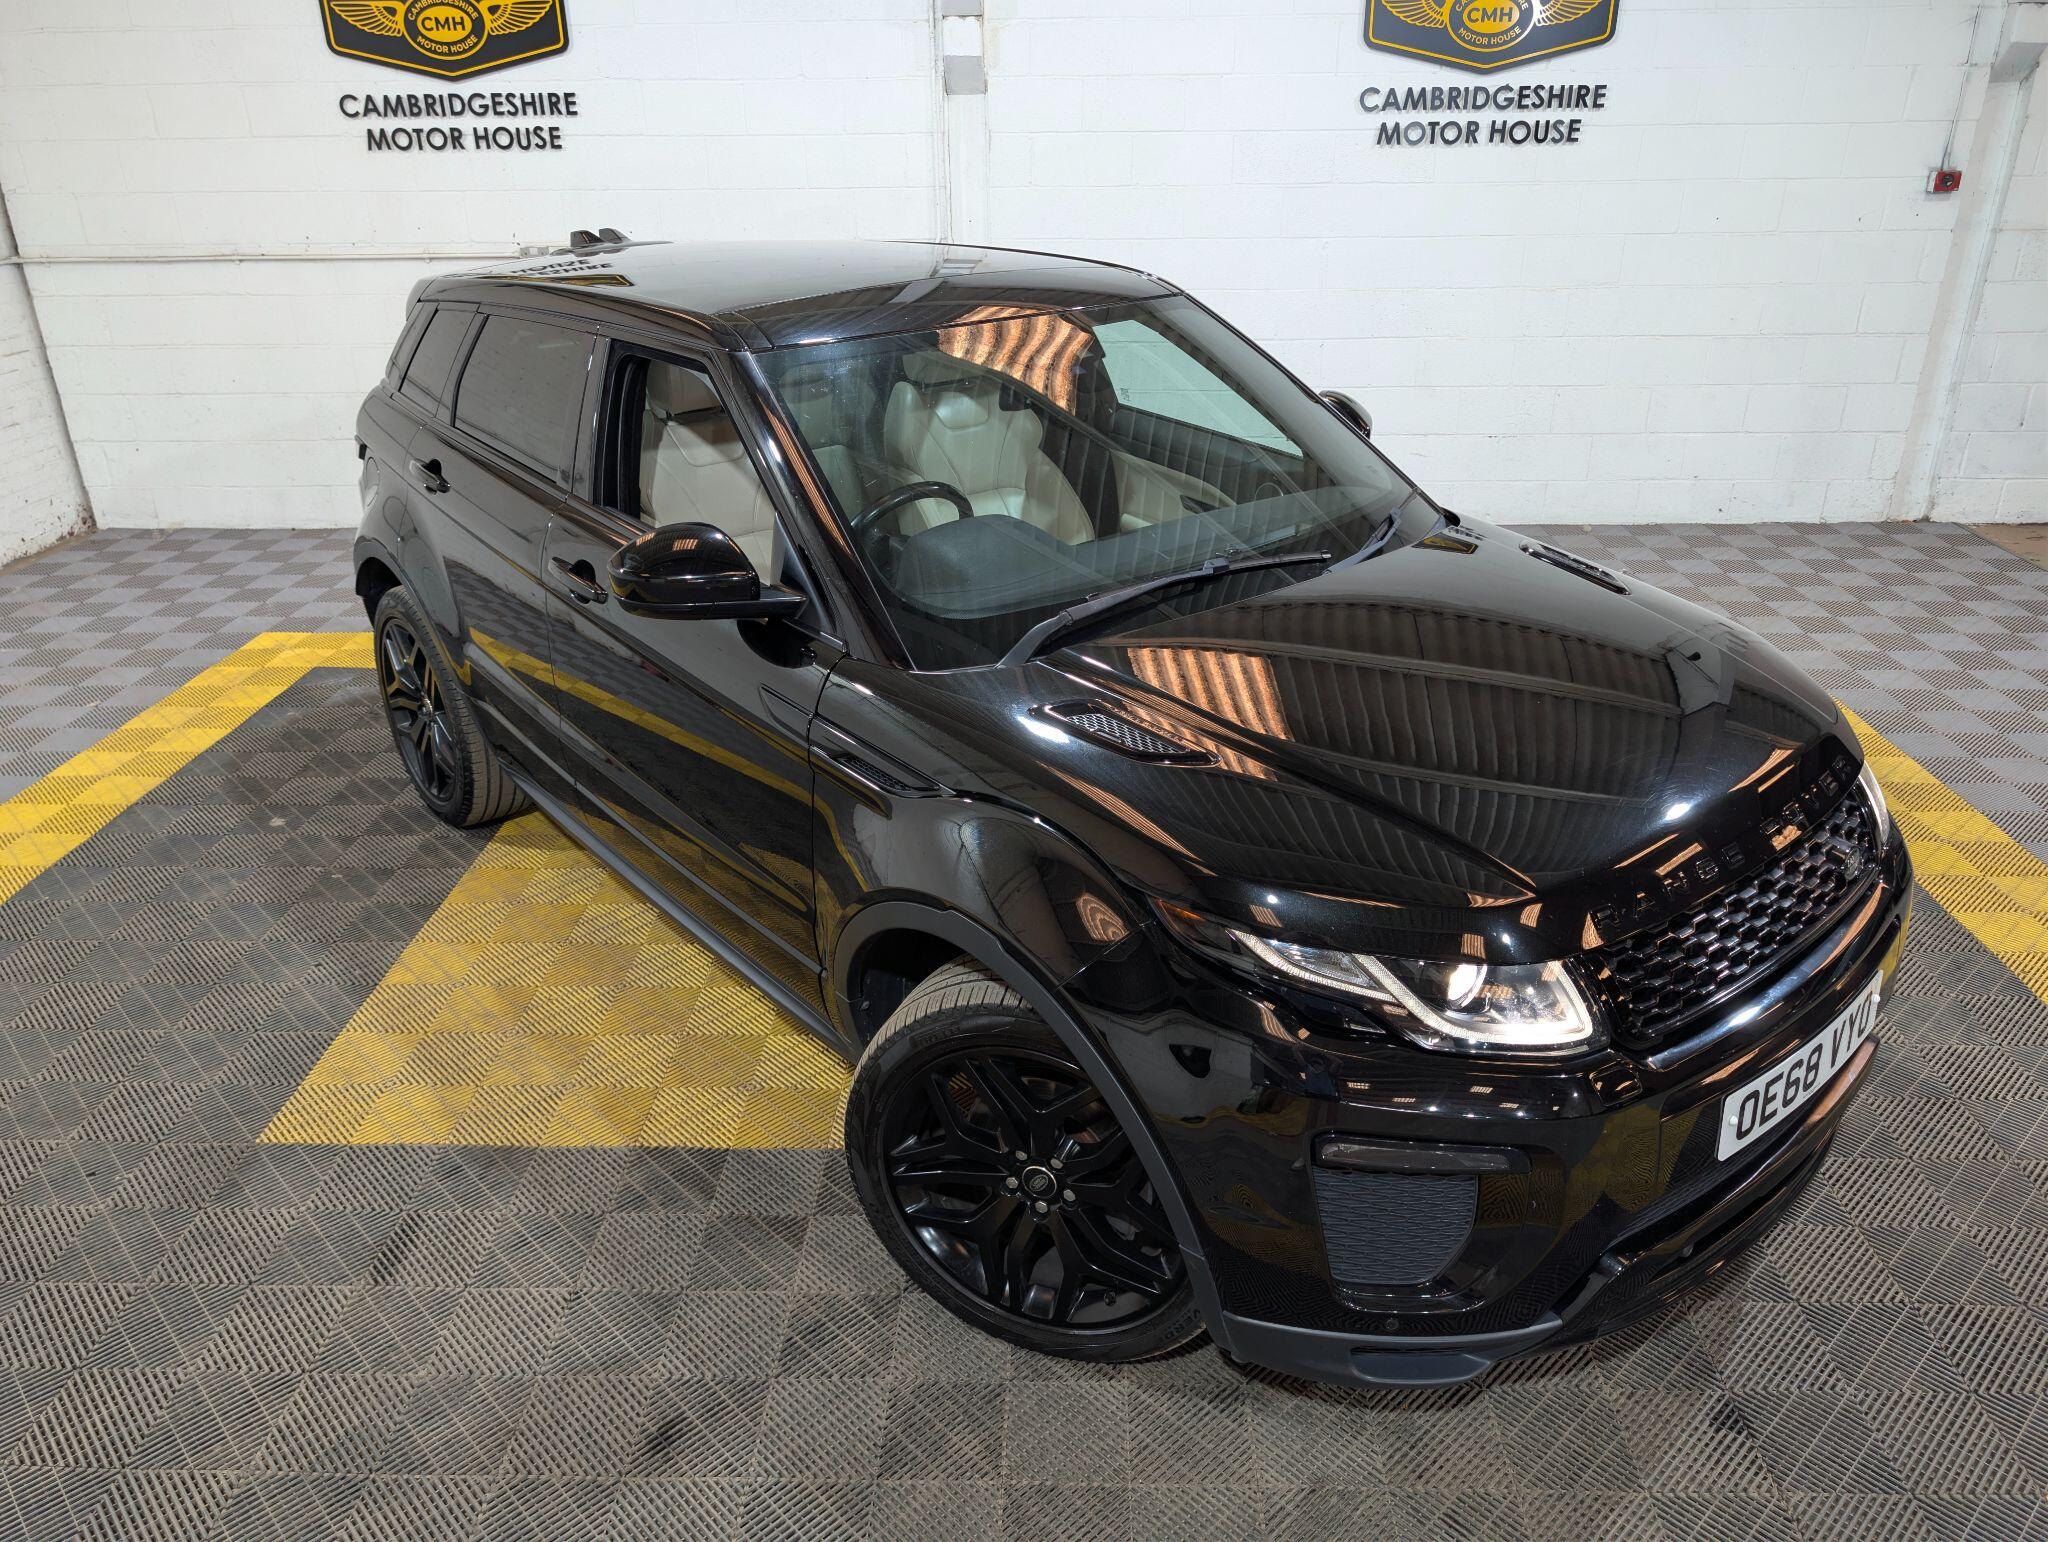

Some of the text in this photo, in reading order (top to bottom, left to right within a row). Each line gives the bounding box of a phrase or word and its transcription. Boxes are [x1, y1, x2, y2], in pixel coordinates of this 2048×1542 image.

[421, 16, 466, 32] CMH
[1467, 7, 1513, 23] CMH
[417, 34, 478, 53] MOTOR HOUSE
[1459, 25, 1521, 45] MOTOR HOUSE
[339, 92, 578, 119] CAMBRIDGESHIRE
[1359, 84, 1607, 112] CAMBRIDGESHIRE
[367, 126, 563, 151] MOTOR HOUSE
[1376, 119, 1582, 145] MOTOR HOUSE
[1736, 989, 1873, 1141] OE68 VYO
